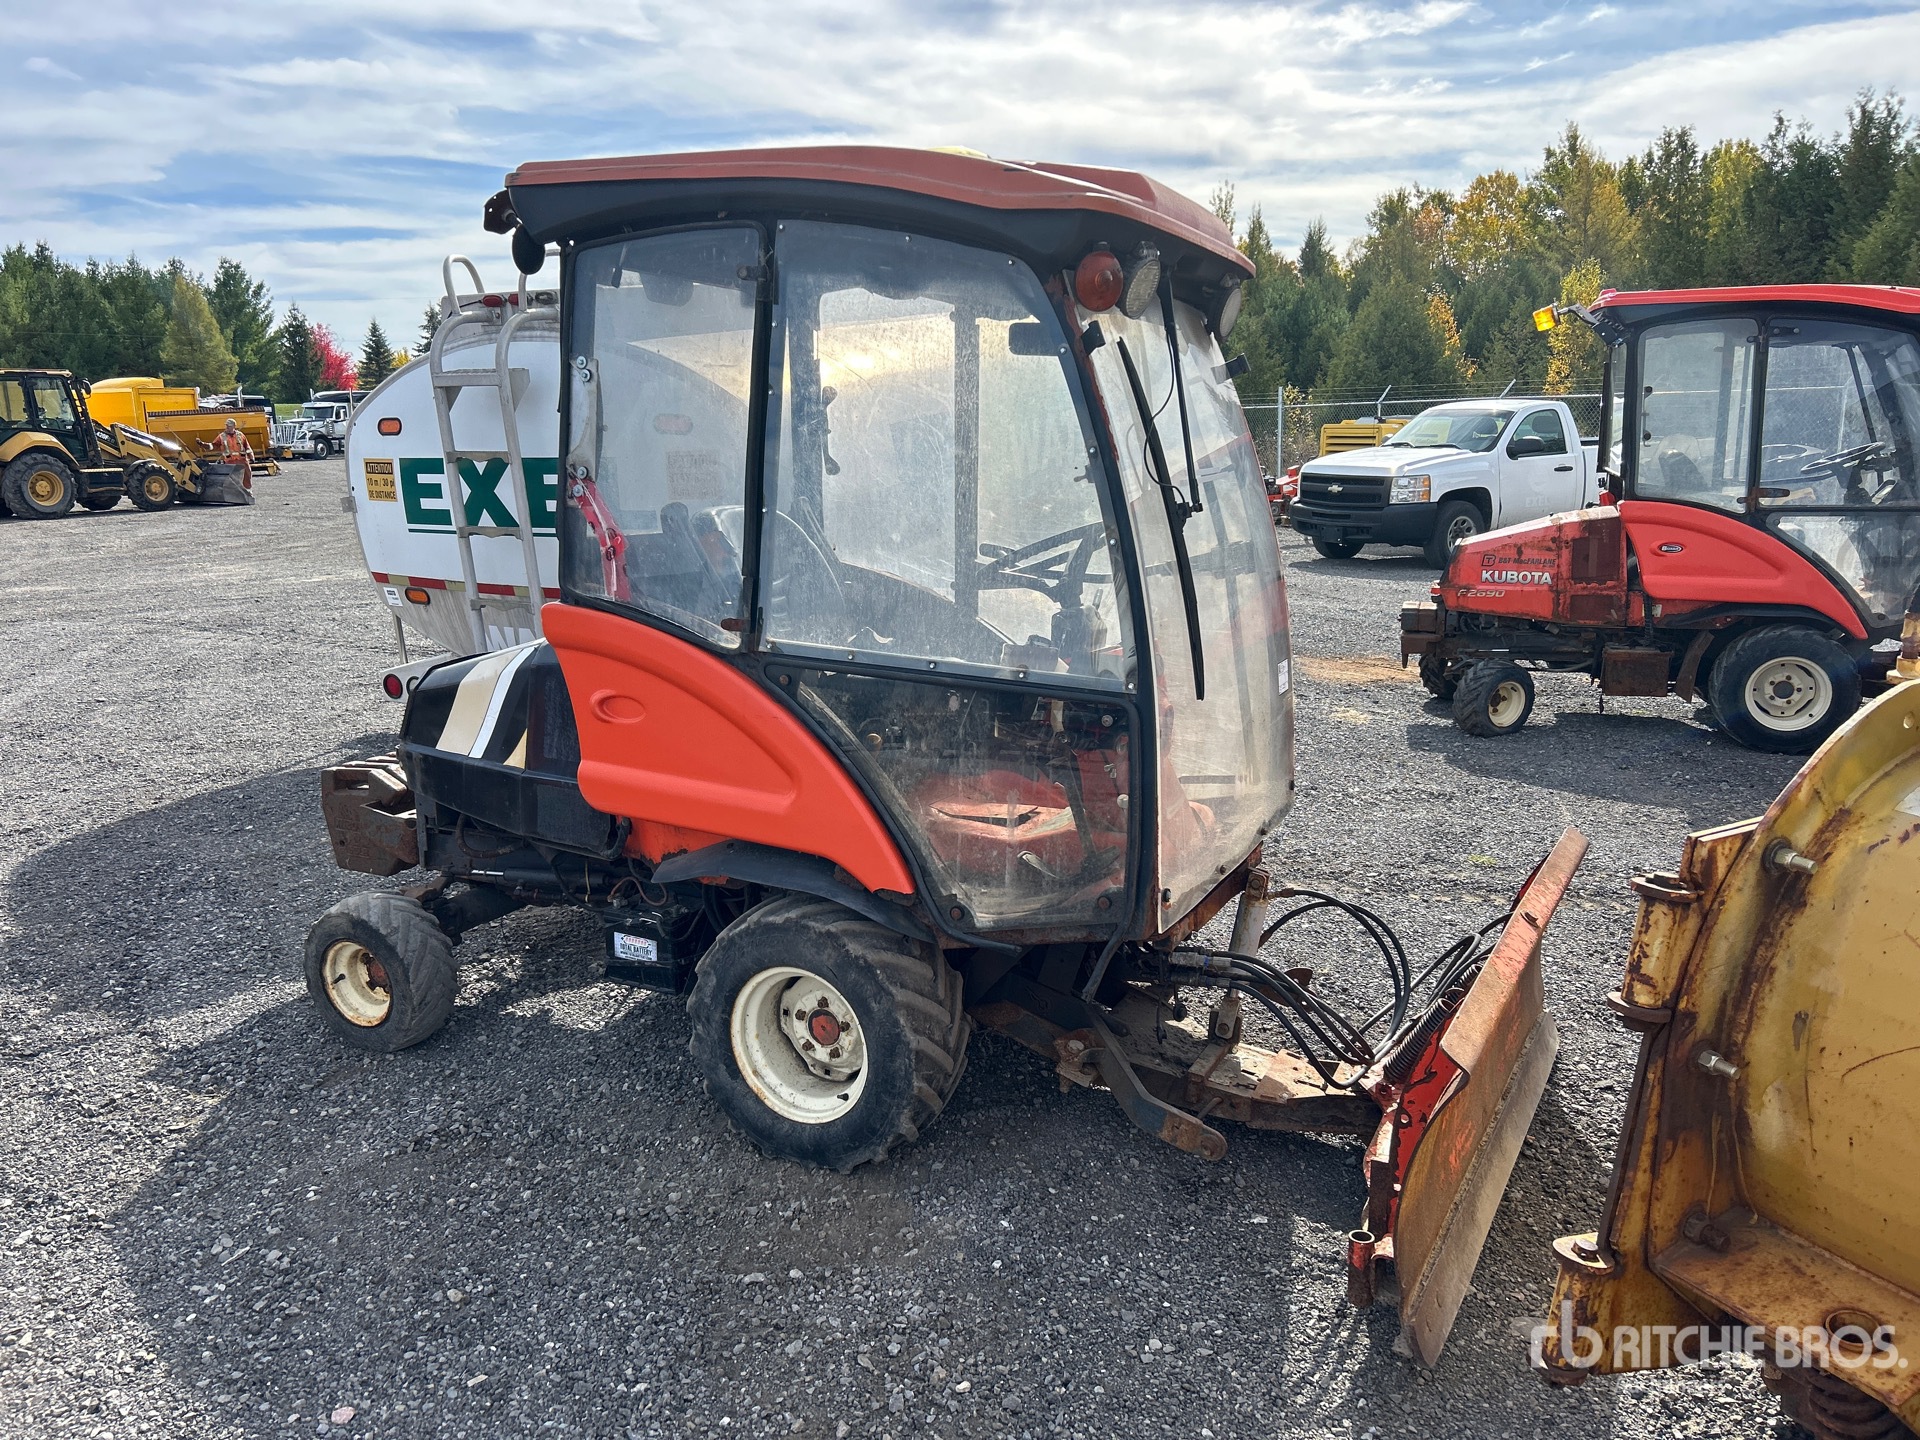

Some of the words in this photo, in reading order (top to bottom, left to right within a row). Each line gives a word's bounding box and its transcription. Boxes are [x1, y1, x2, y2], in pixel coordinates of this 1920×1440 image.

[367, 463, 392, 473] ATTENTION
[367, 478, 373, 486] 10
[382, 478, 389, 486] 30
[369, 490, 375, 498] DE
[375, 491, 396, 499] DISTANCE
[1481, 570, 1552, 585] KUBOTA
[1457, 589, 1506, 597] F2690
[620, 942, 632, 951] TOTAL
[633, 946, 653, 956] BATTERY
